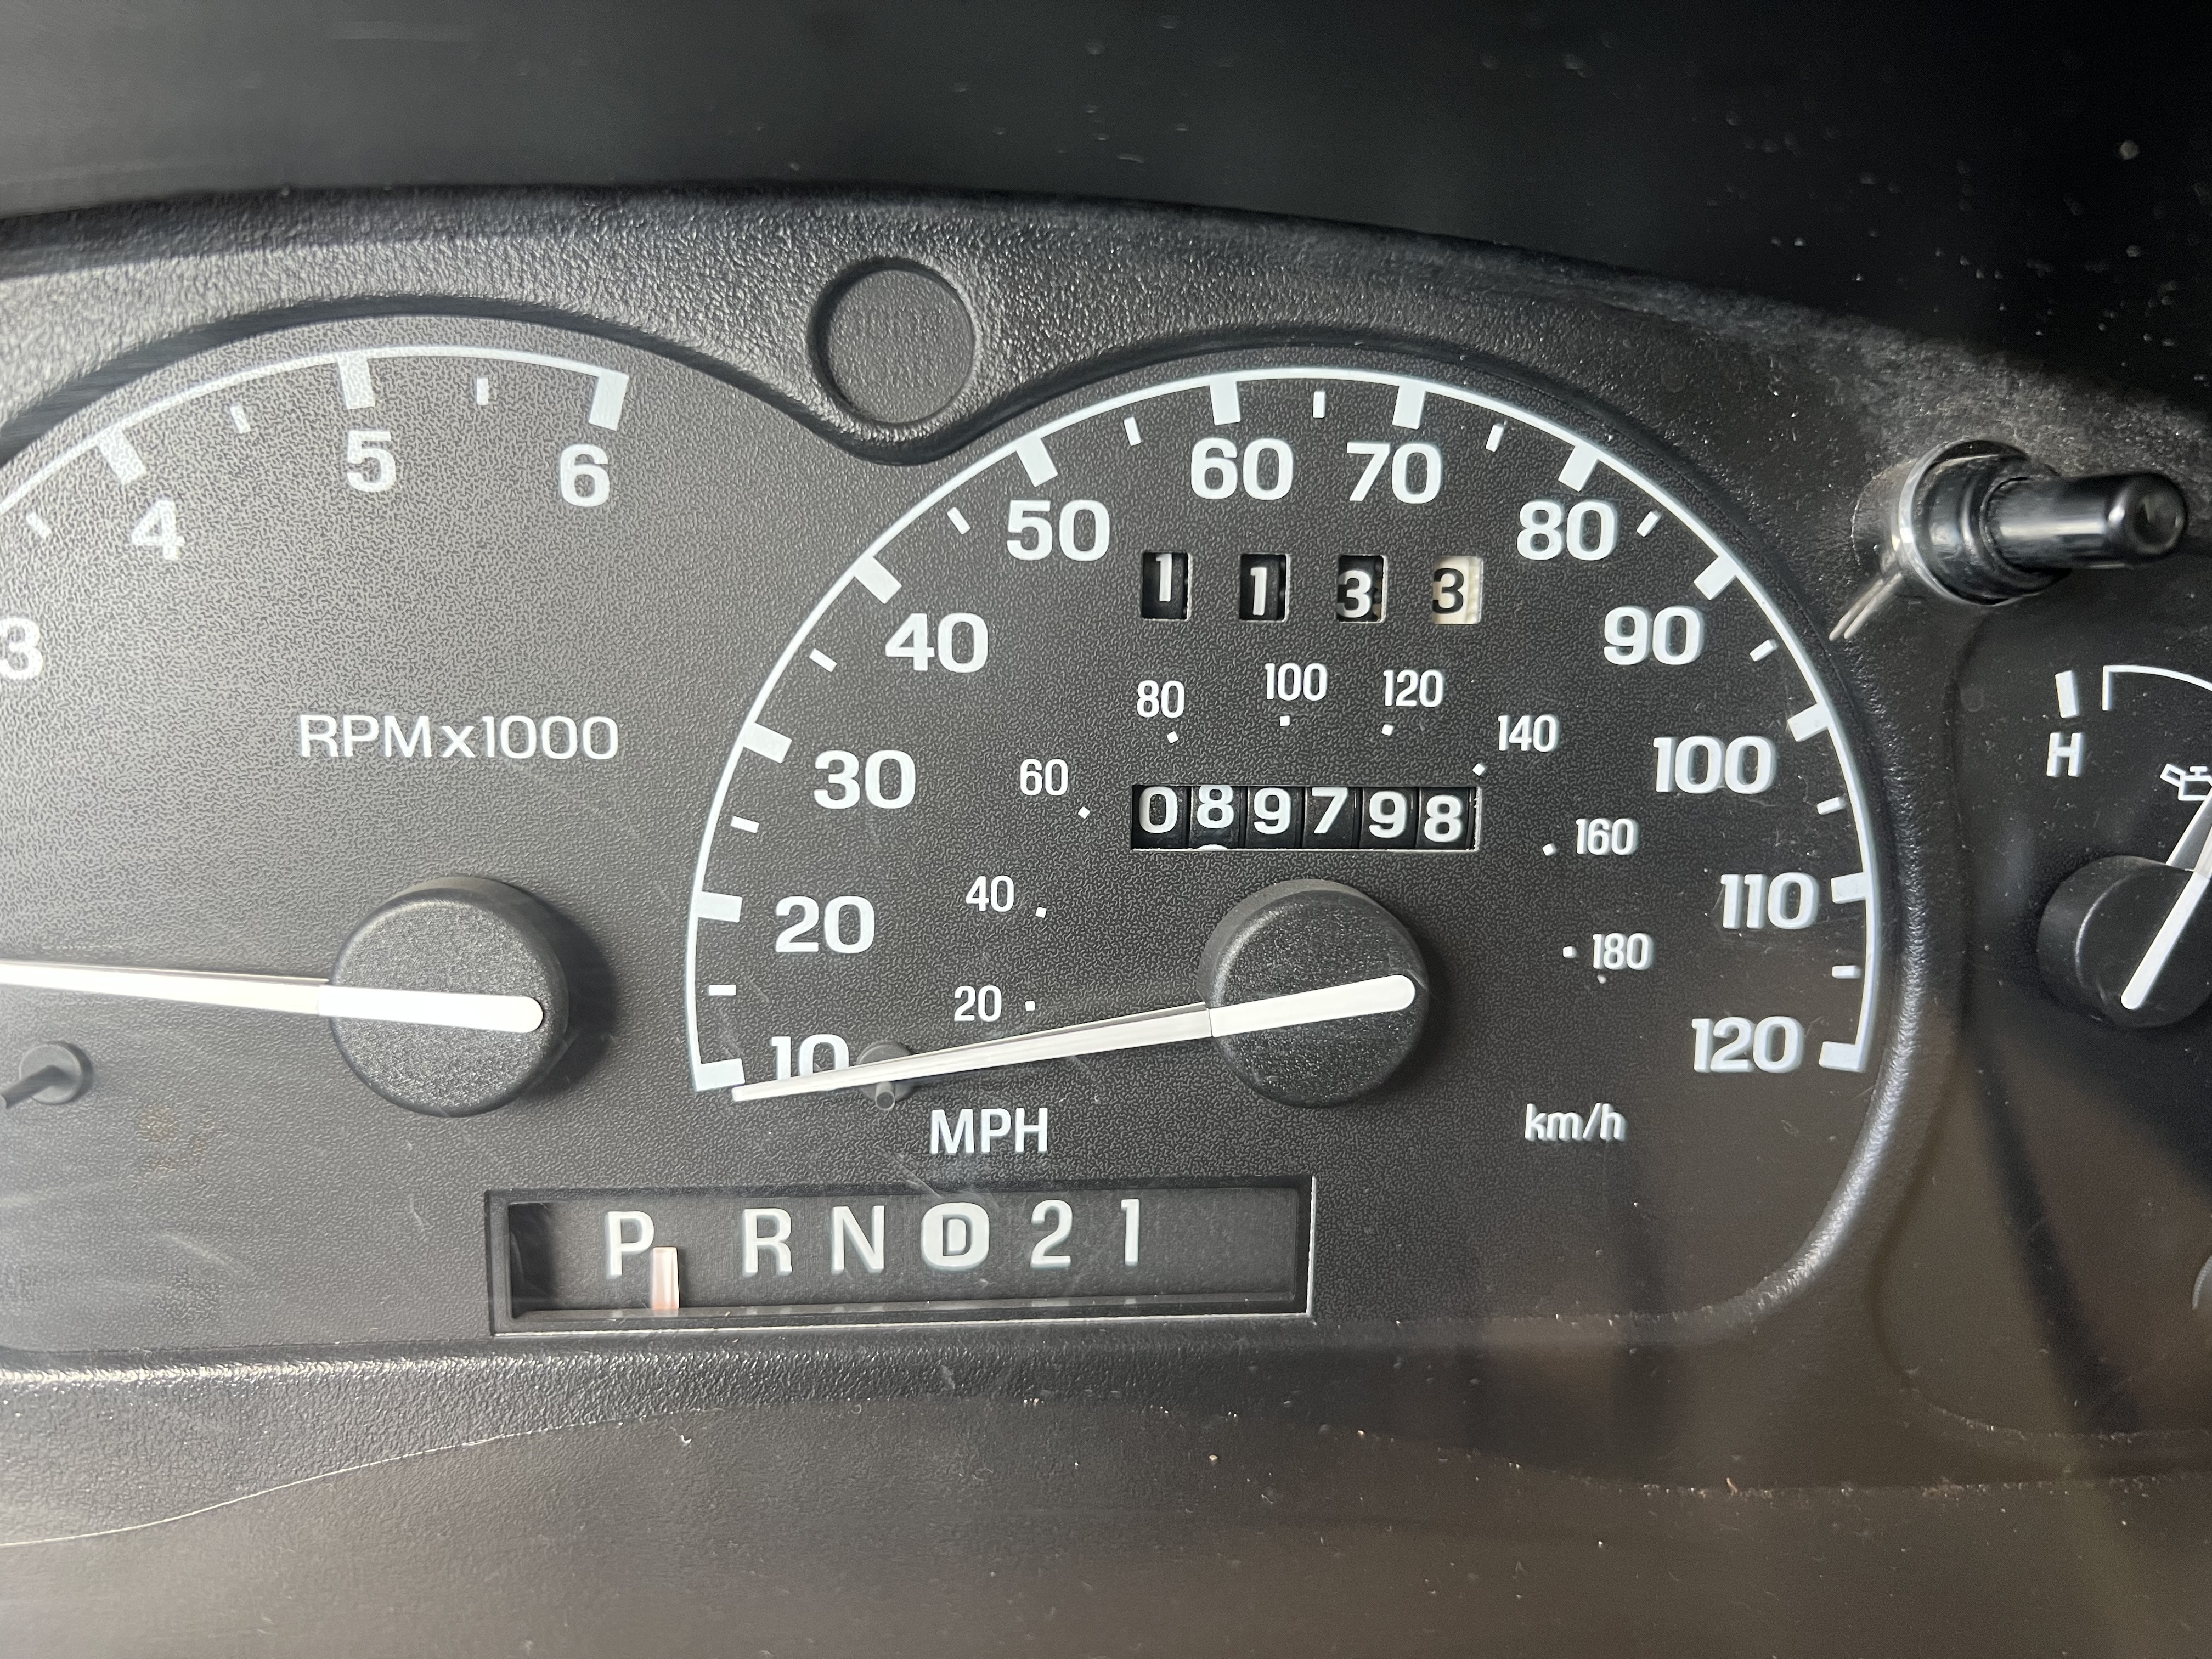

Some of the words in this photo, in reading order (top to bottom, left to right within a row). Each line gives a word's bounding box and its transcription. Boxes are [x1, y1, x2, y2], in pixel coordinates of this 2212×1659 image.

[347, 430, 396, 492] 5
[560, 444, 610, 507] 6
[1191, 437, 1293, 500] 60
[1347, 442, 1442, 503] 70
[131, 499, 184, 561] 4
[1007, 500, 1109, 561] 50
[1517, 500, 1616, 560] 80
[0, 616, 43, 680] 3
[885, 613, 988, 673] 40
[1604, 606, 1702, 665] 90
[1137, 680, 1184, 718] 80
[1265, 663, 1327, 701] 100
[1384, 670, 1443, 707] 120
[1498, 715, 1558, 752] 140
[2047, 732, 2082, 776] H
[814, 751, 915, 809] 30
[1020, 759, 1068, 795] 60
[1654, 736, 1774, 794] 100
[1142, 785, 1462, 842] 089798
[1576, 819, 1637, 855] 160
[966, 876, 1014, 912] 40
[1721, 873, 1817, 929] 110
[776, 896, 874, 953] 20
[1593, 933, 1651, 969] 180
[955, 985, 1001, 1022] 20
[771, 1035, 850, 1079] 10
[1692, 1017, 1802, 1072] 120
[930, 1108, 1047, 1154] MPH
[1525, 1103, 1624, 1140] km/h
[606, 1210, 654, 1277] P
[743, 1209, 792, 1276] R
[832, 1206, 884, 1273] N
[1031, 1200, 1072, 1267] 2
[1121, 1199, 1139, 1265] 1
